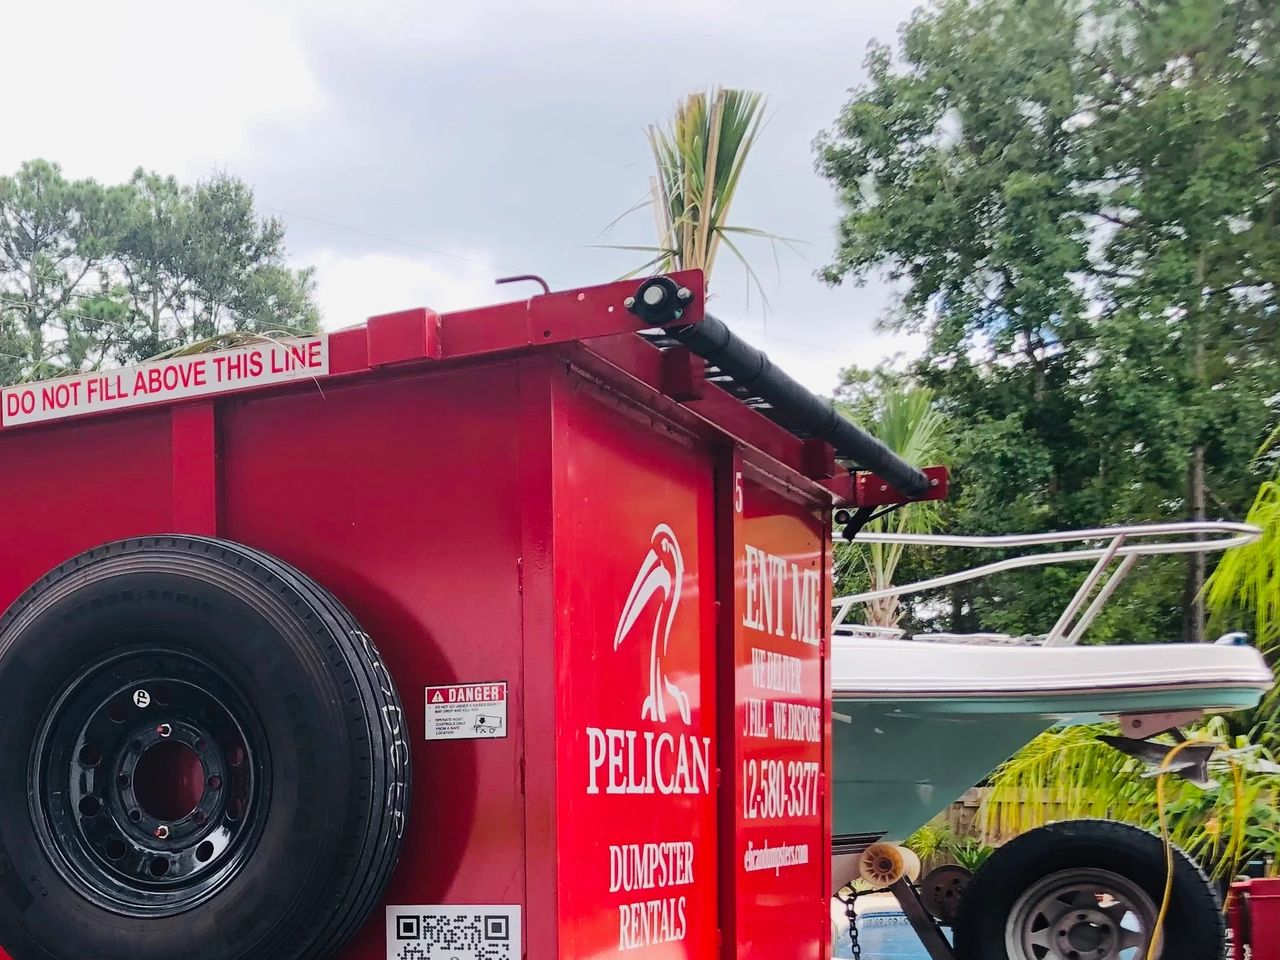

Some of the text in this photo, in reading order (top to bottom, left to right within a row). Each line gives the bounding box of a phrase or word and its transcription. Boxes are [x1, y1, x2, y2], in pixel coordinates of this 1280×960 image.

[7, 341, 323, 417] DO NOT FILL ABOVE THIS LINE
[742, 544, 820, 646] ENT ME
[448, 686, 499, 702] DANGER
[752, 648, 801, 694] WE DELIVER
[750, 698, 768, 737] FILL
[773, 702, 787, 739] WE
[788, 704, 820, 742] DISPOSE
[586, 727, 710, 794] PELICAN
[609, 842, 694, 892] DUMPSTER
[619, 897, 686, 951] RENTALS
